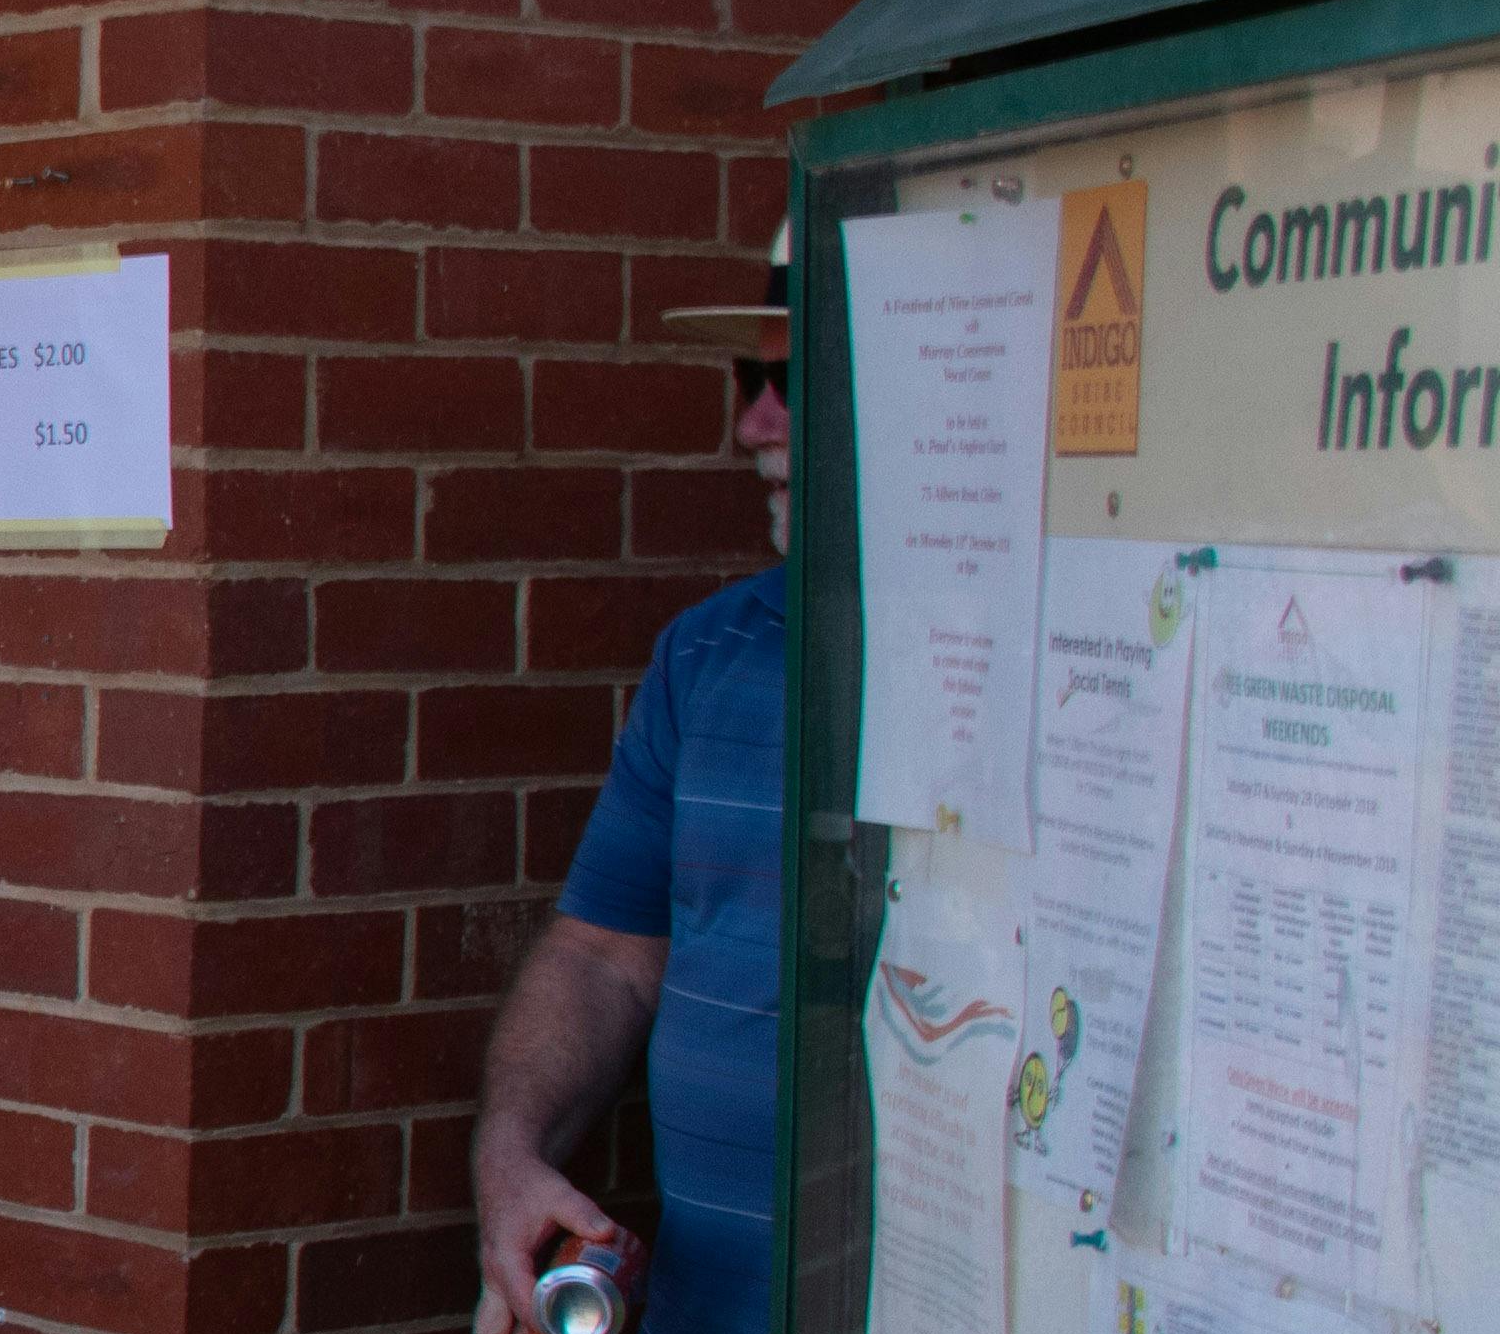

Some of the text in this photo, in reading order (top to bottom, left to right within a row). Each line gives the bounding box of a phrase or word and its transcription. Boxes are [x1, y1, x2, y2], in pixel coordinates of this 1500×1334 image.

[1205, 142, 1500, 294] Communi
[33, 343, 86, 371] $2.00
[1061, 321, 1137, 372] INDIGO
[34, 422, 89, 450] $1.50
[1049, 633, 1101, 658] Interested
[1243, 676, 1278, 701] GREEN
[1279, 680, 1325, 708] WASTE
[1326, 685, 1397, 715] DISPOSAL
[1262, 717, 1331, 748] WEEKENDS
